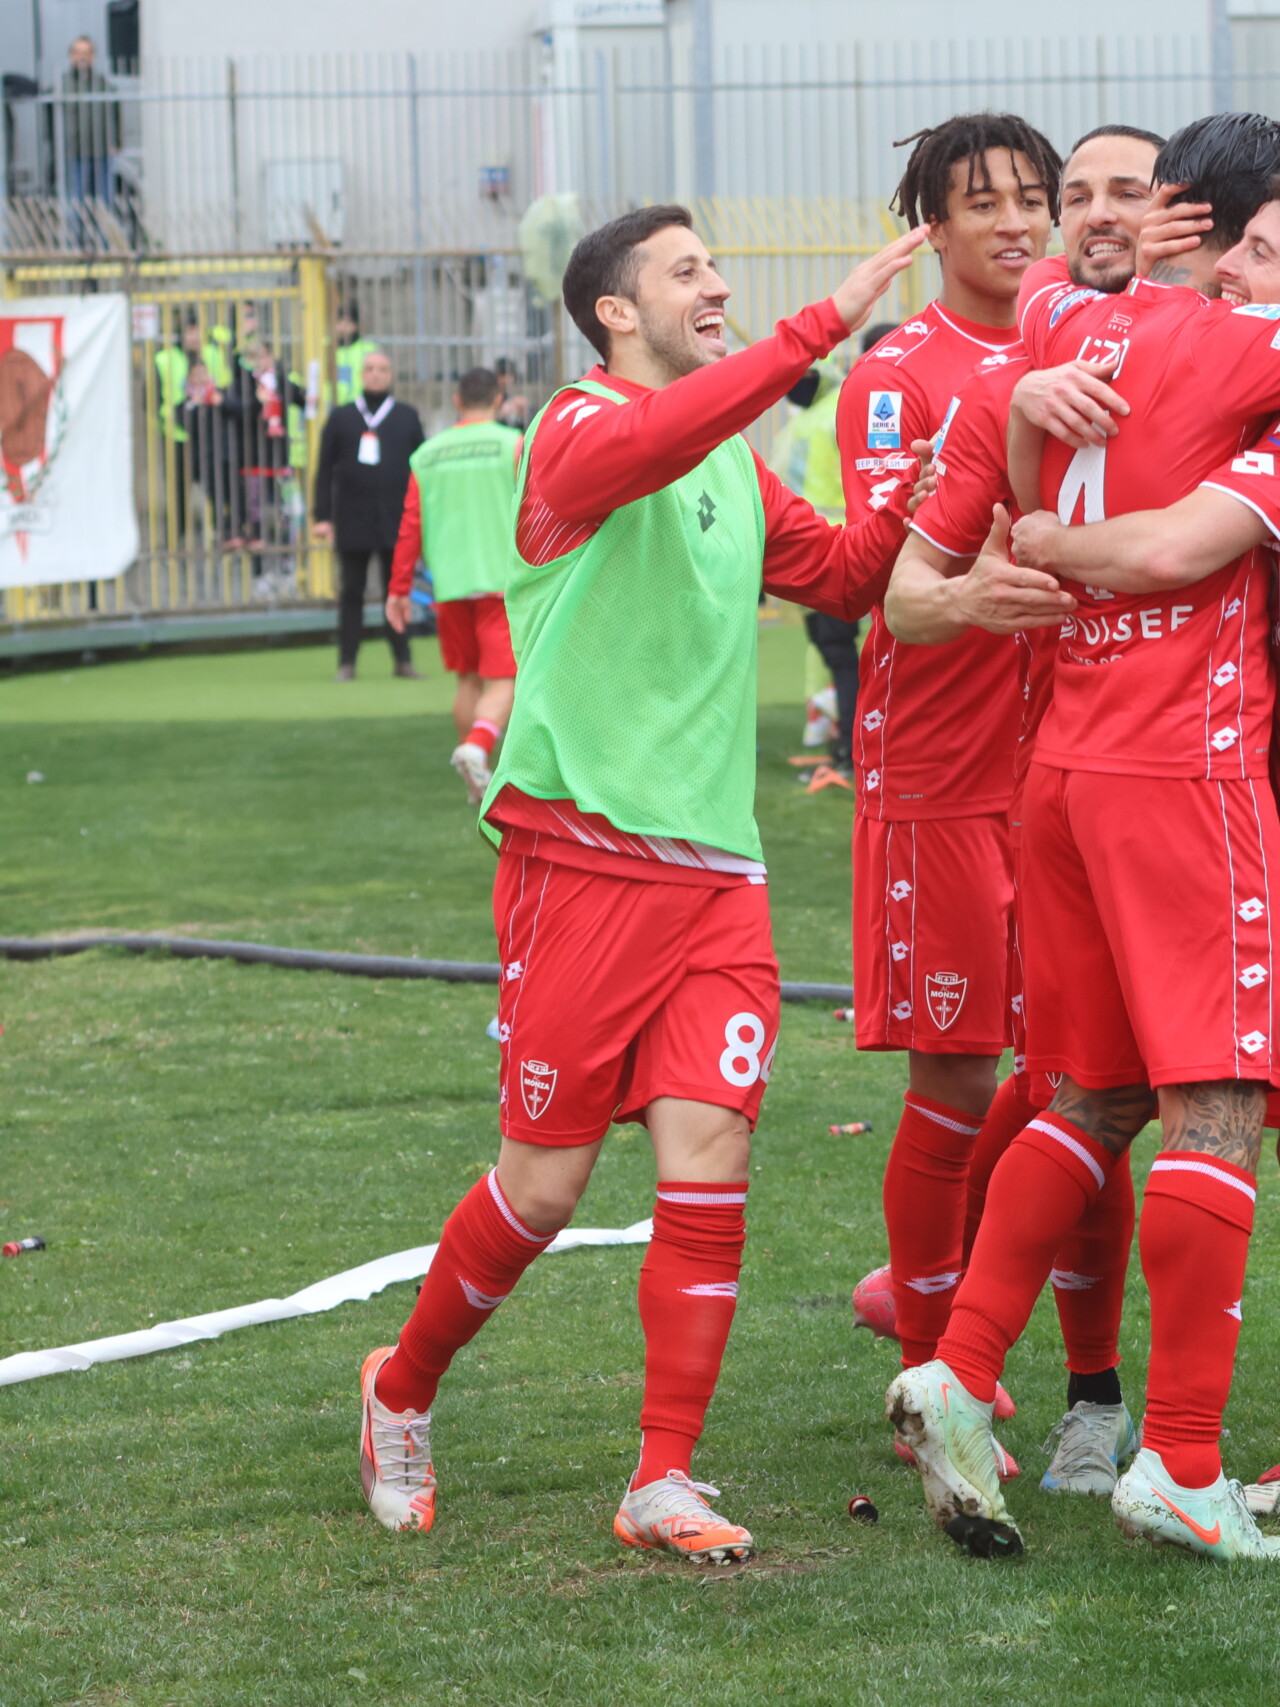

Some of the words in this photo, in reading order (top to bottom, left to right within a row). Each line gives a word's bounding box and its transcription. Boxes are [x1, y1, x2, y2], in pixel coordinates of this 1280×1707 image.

[857, 460, 870, 469] EEP
[930, 991, 960, 999] MONZA
[524, 1078, 550, 1090] MONZA
